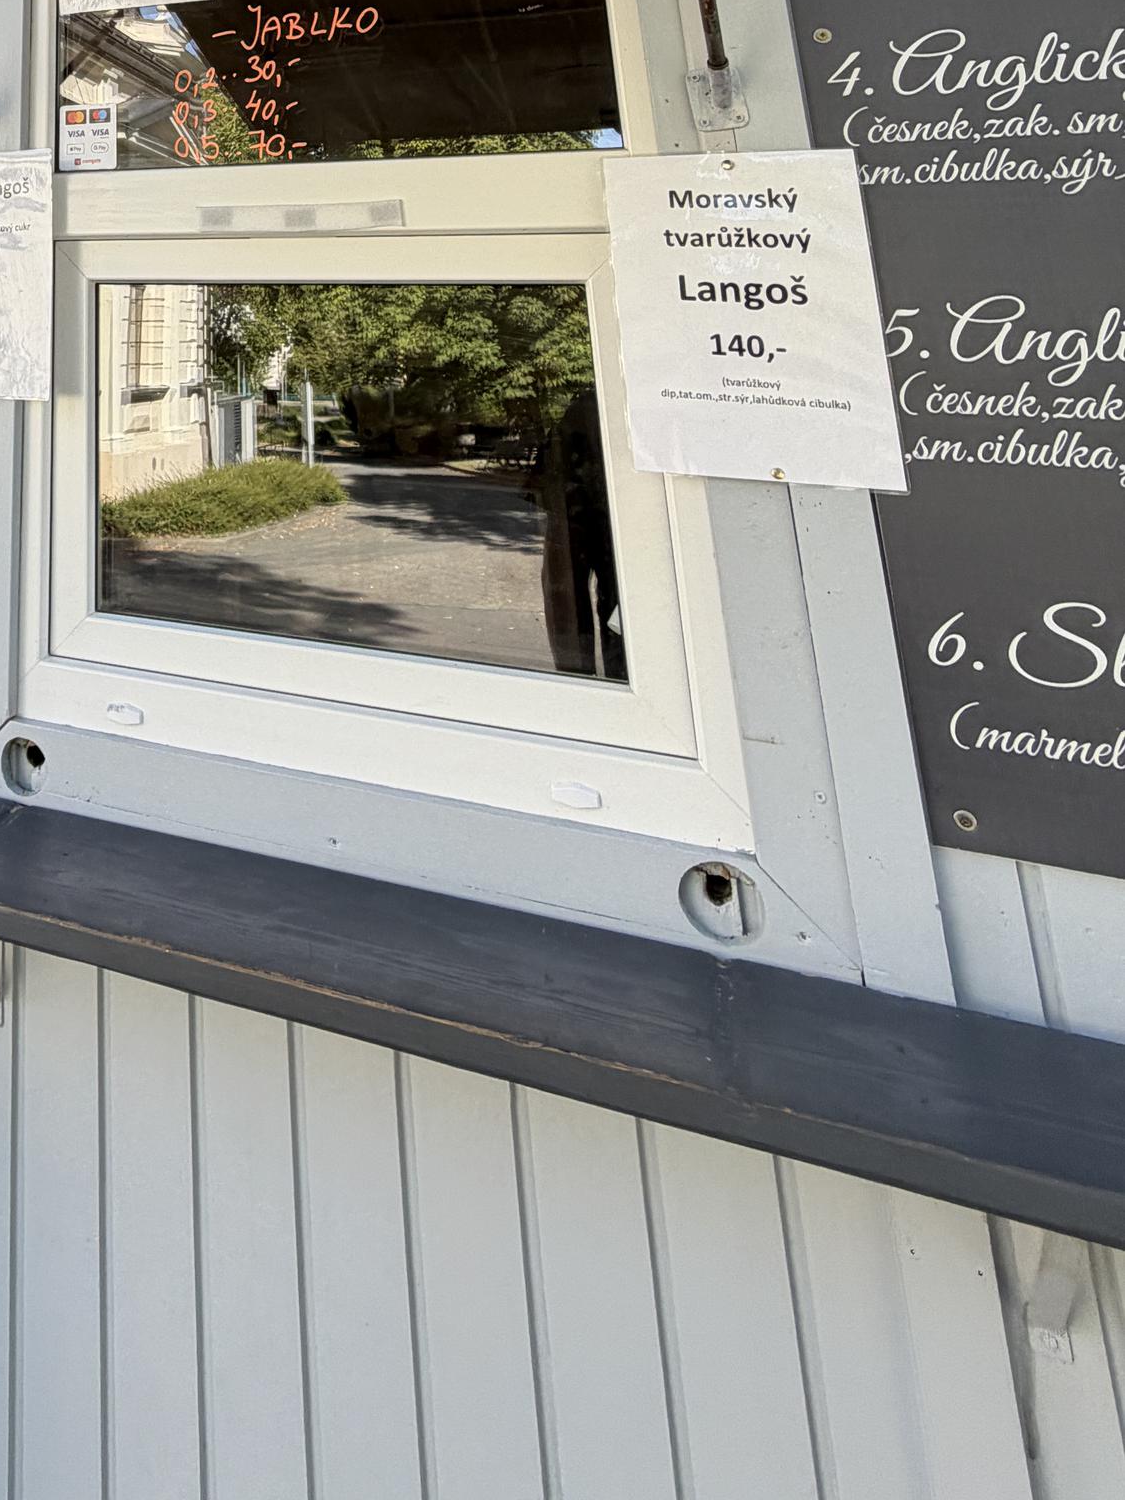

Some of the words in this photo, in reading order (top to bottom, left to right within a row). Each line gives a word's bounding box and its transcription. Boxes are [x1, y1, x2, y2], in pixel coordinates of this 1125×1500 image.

[827, 51, 874, 96] 4.
[889, 28, 1125, 111] Anglick
[67, 129, 86, 138] VISA
[91, 128, 110, 137] VISA
[668, 187, 798, 214] Moravský
[663, 227, 812, 254] tvarůžkový
[678, 275, 809, 311] Langoš
[709, 334, 787, 363] 140,-
[721, 376, 781, 391] (tvarůžkový
[809, 400, 852, 412] cibulka)
[927, 611, 984, 671] 6.
